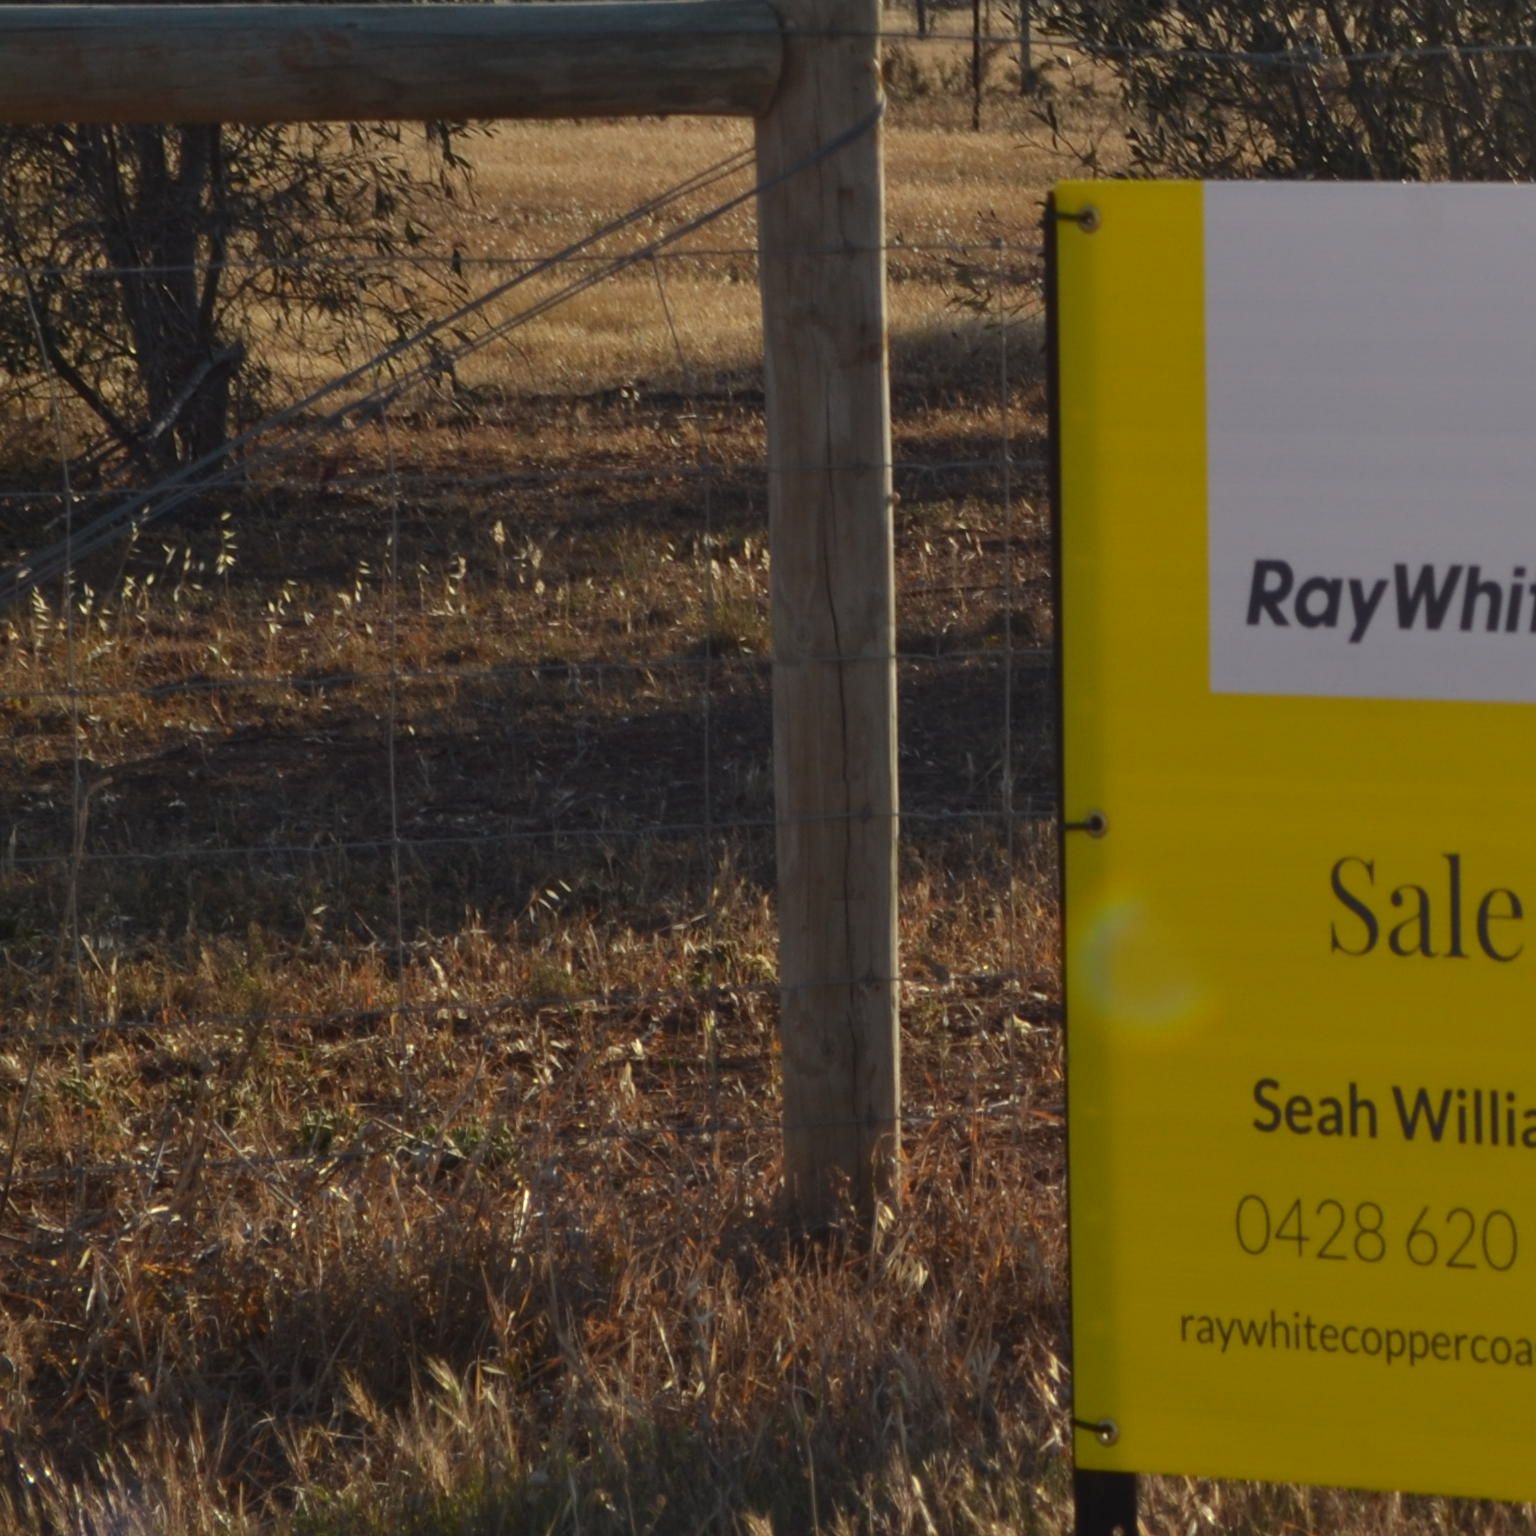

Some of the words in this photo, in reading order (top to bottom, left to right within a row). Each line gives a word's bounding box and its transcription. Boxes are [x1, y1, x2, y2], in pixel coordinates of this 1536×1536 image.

[1330, 852, 1524, 963] Sale
[1252, 1077, 1378, 1139] Seah
[1235, 1193, 1387, 1264] 0428
[1405, 1205, 1519, 1273] 620
